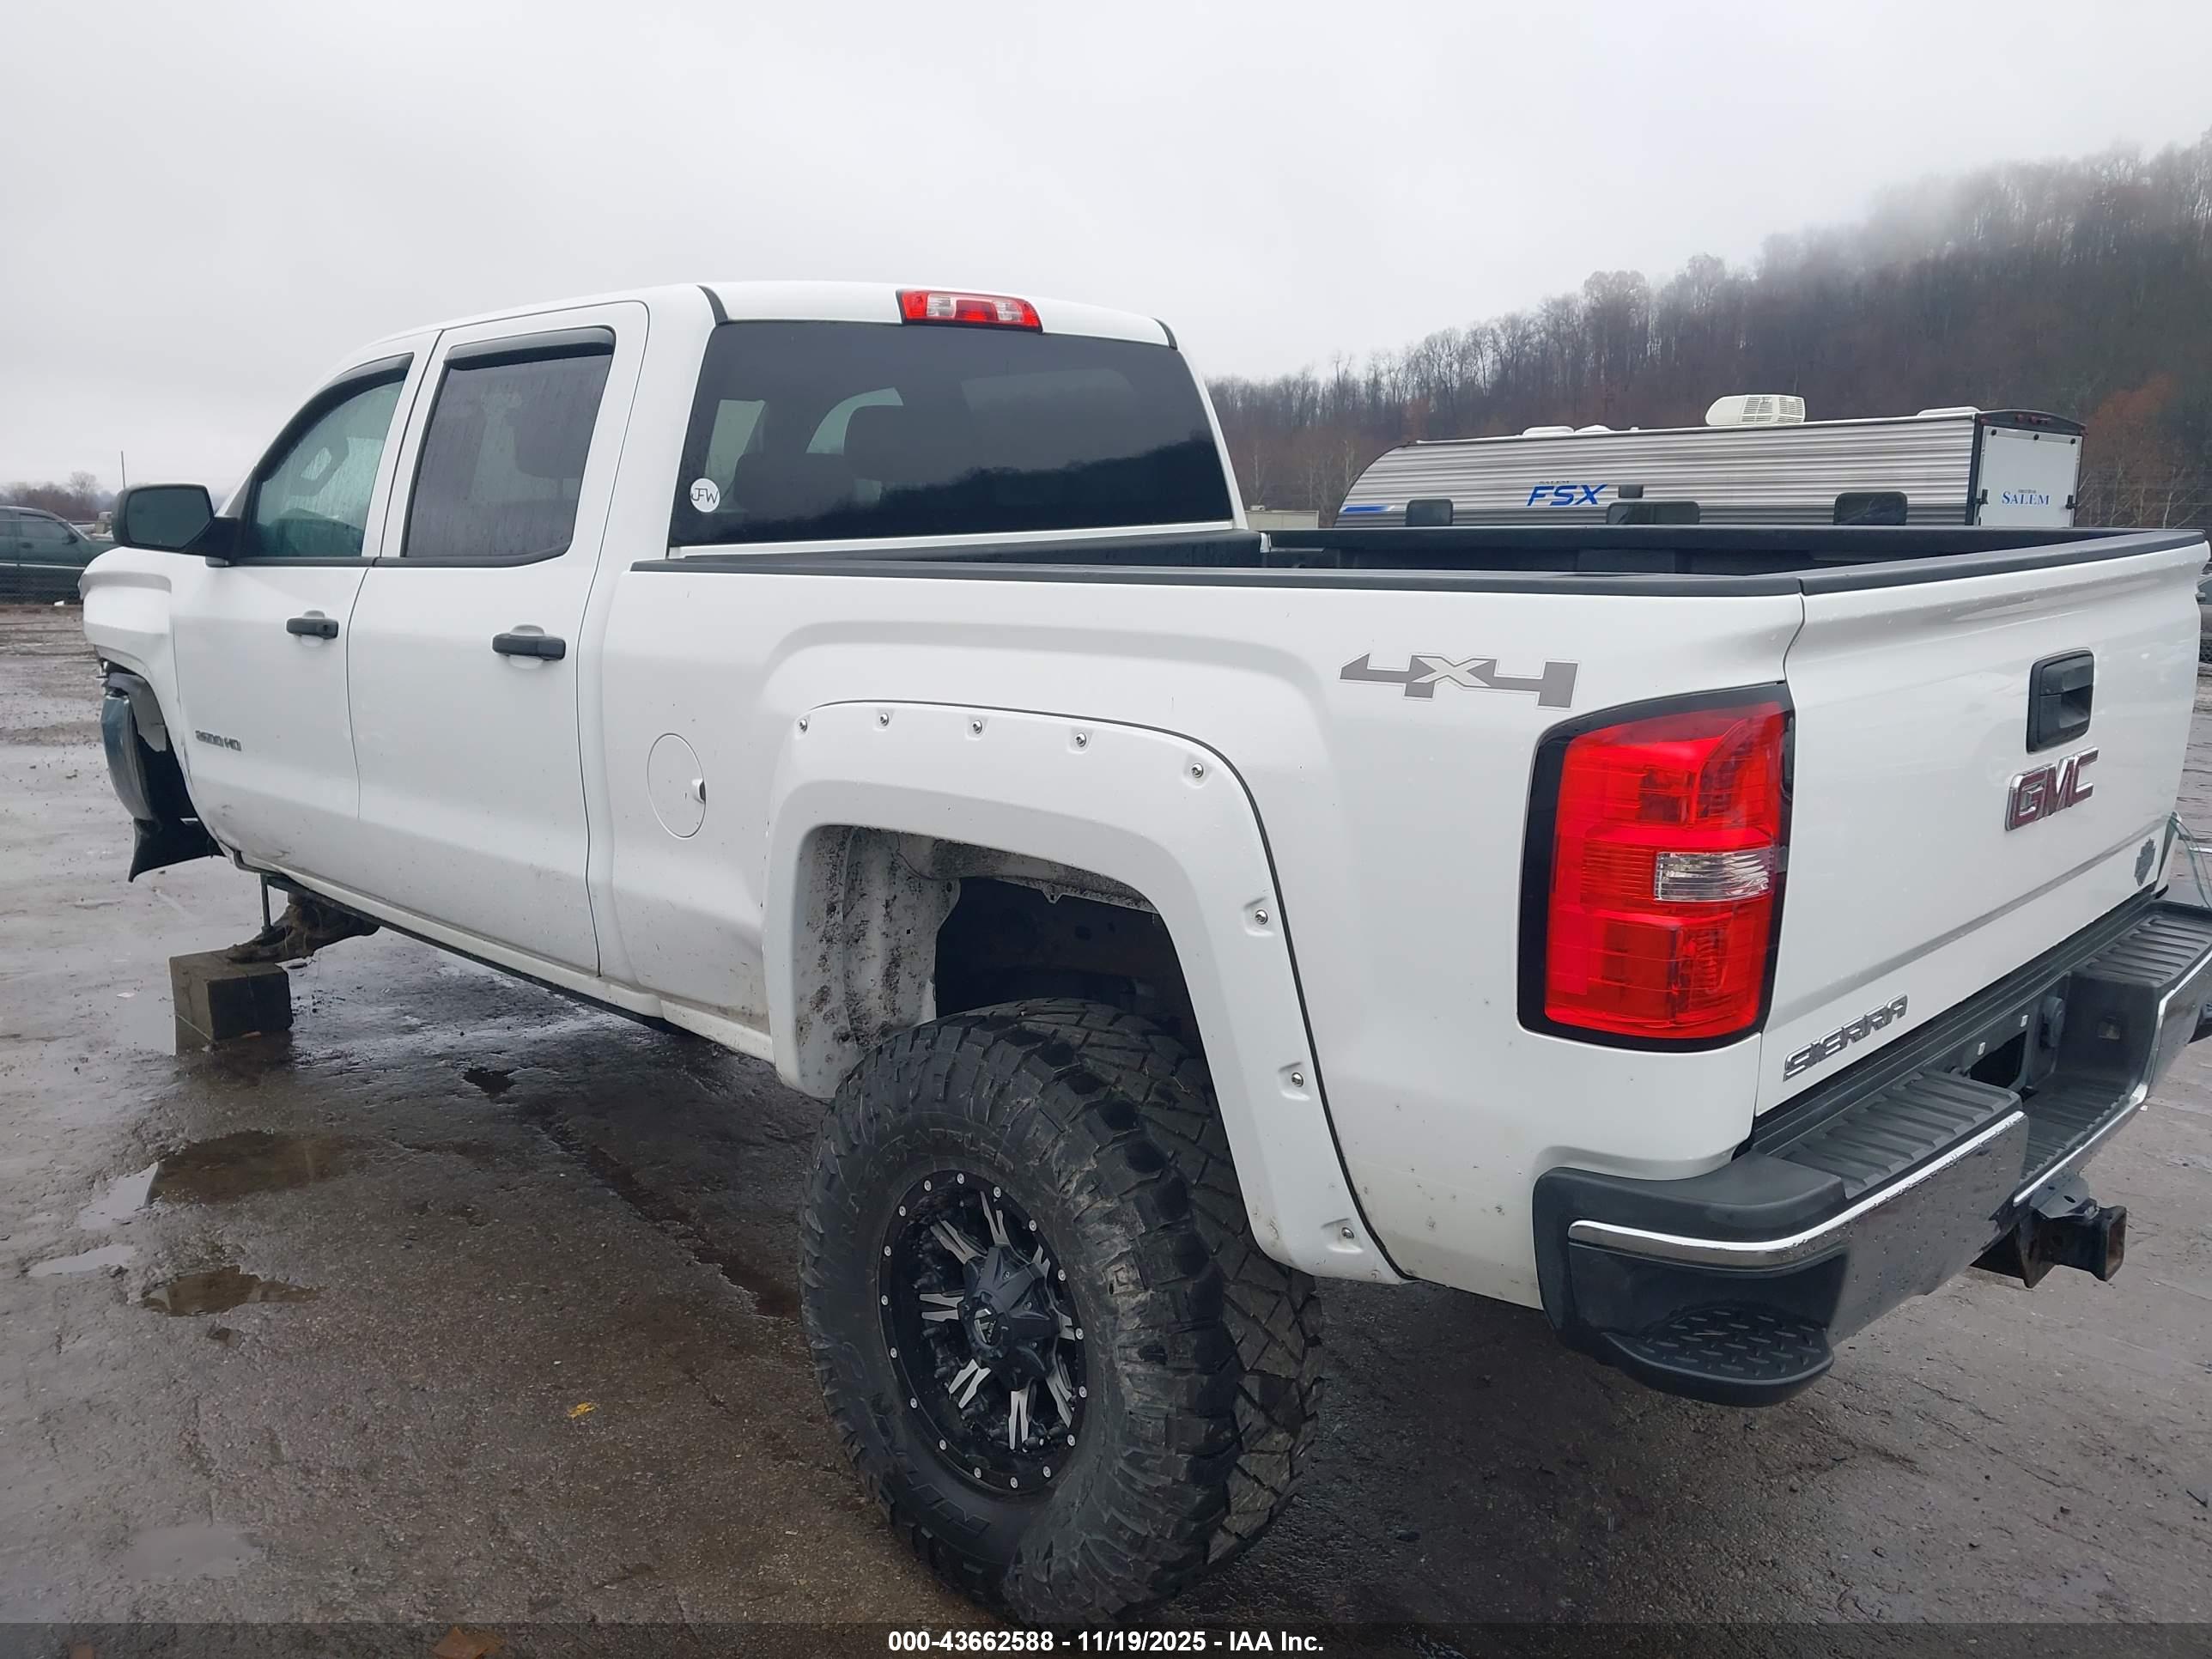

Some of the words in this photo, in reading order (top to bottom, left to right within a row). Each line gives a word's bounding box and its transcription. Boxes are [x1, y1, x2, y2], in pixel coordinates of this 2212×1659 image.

[1527, 484, 1607, 506] FSX
[2002, 491, 2049, 505] SALEM
[2005, 745, 2099, 831] GMC
[1783, 994, 1908, 1082] SIERRA
